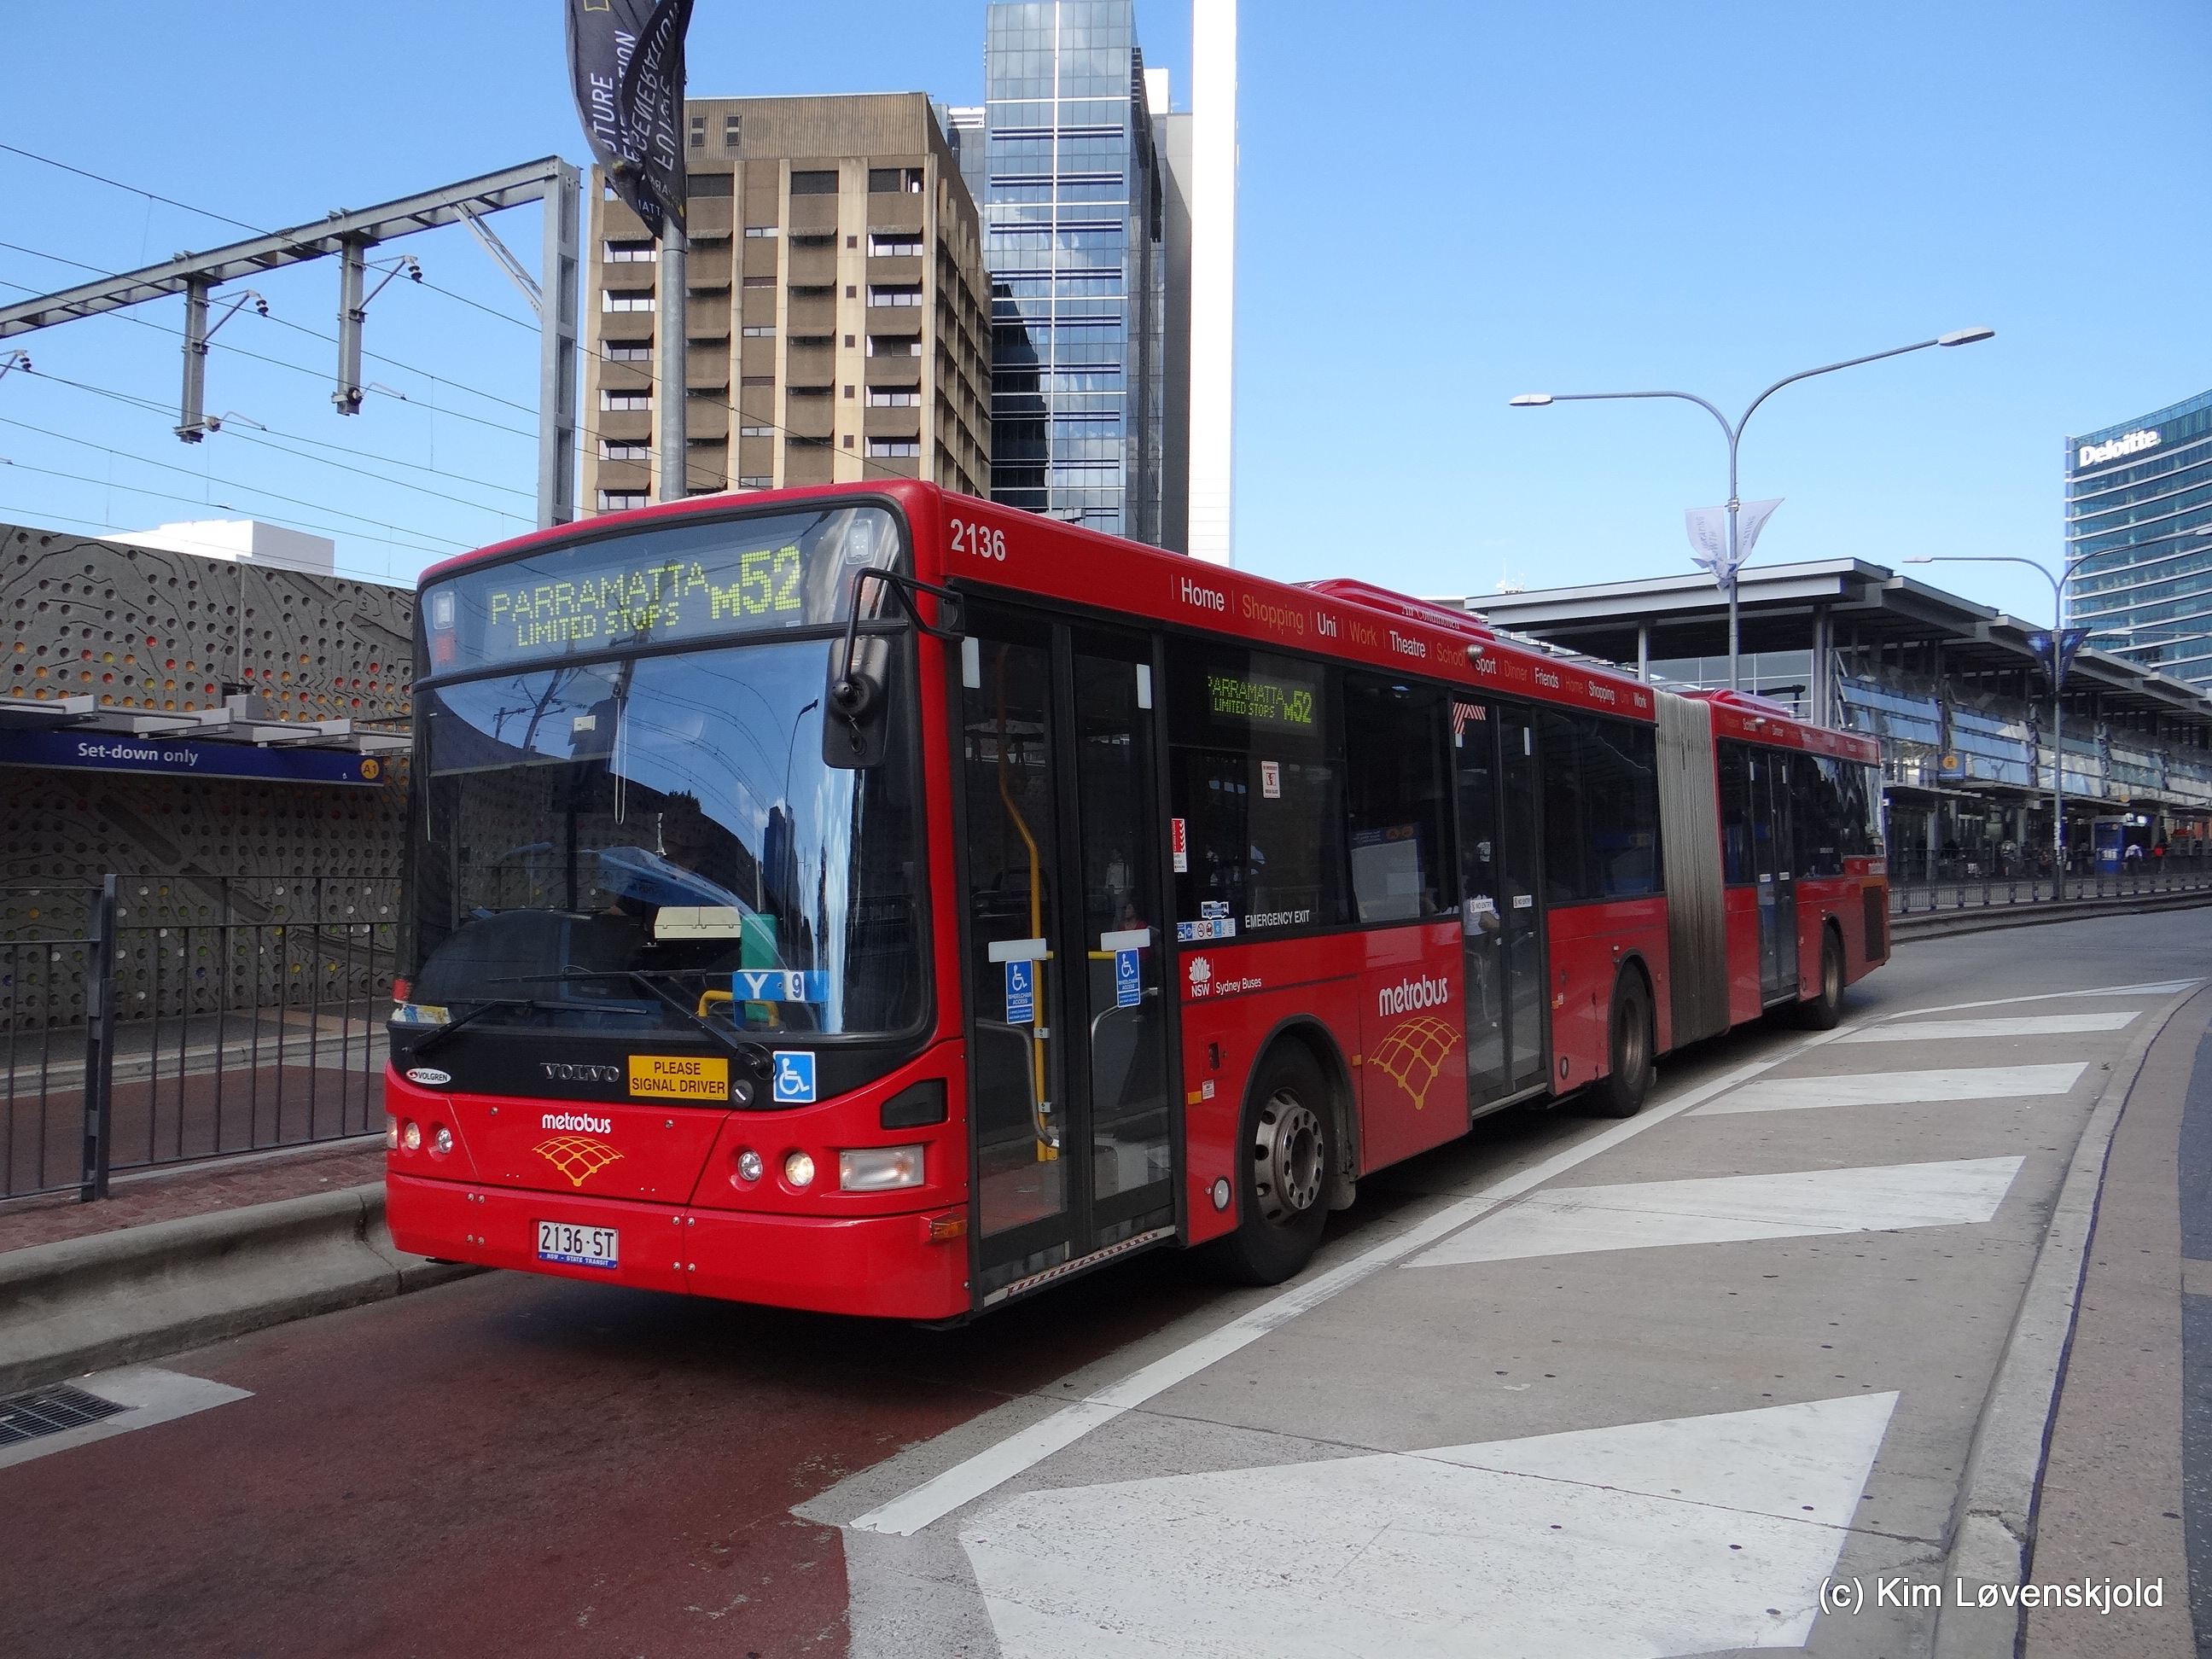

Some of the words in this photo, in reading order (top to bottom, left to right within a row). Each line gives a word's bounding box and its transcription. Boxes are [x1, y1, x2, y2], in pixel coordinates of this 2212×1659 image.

[950, 518, 1006, 561] 2136
[492, 562, 708, 626] PARRAMATTA
[518, 614, 596, 646] LIMITED
[605, 602, 679, 635] STOPS
[1180, 577, 1225, 611] Home
[1243, 594, 1303, 636] Shopping
[1317, 612, 1336, 637] Uni
[1349, 620, 1377, 647] Work
[1389, 631, 1426, 658] Theatre
[1437, 642, 1465, 666] School
[1505, 660, 1528, 682] Dinner
[1534, 667, 1559, 690] Friends
[1588, 680, 1615, 705] Shopping
[1633, 692, 1647, 709] Work
[1214, 697, 1246, 714] LIMITED
[1249, 702, 1275, 718] STOPS
[79, 742, 158, 761] Set-down
[164, 748, 199, 766] only
[364, 760, 378, 774] A1
[1245, 911, 1293, 928] EMERGENCY
[1295, 910, 1310, 923] EXIT
[743, 974, 768, 998] Y
[791, 974, 802, 998] 9
[1191, 983, 1209, 997] NSW
[1216, 981, 1241, 995] Sydney
[1243, 977, 1261, 990] Buses
[1379, 974, 1448, 1016] metrobus
[418, 1072, 448, 1082] VOLGREN
[539, 1062, 620, 1083] VOLVO
[654, 1061, 701, 1075] PLEASE
[632, 1078, 676, 1092] SIGNAL
[679, 1080, 725, 1094] DRIVER
[542, 1113, 611, 1134] metrobus
[566, 1254, 583, 1263] STATE
[585, 1257, 609, 1266] TRANSIT
